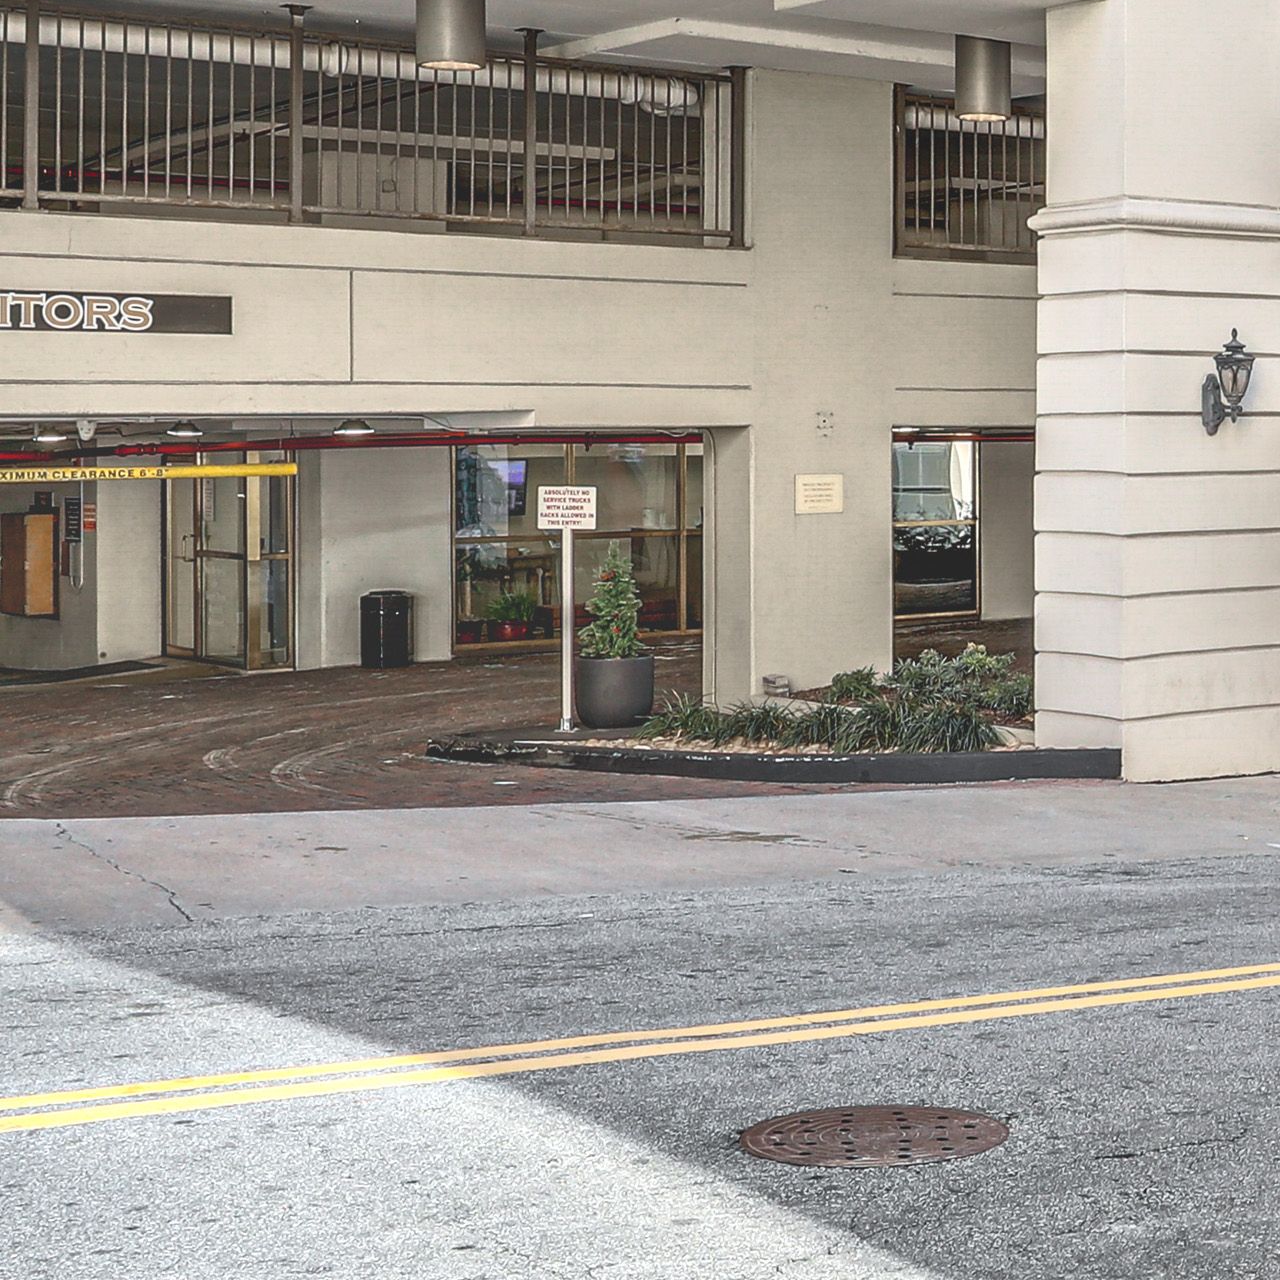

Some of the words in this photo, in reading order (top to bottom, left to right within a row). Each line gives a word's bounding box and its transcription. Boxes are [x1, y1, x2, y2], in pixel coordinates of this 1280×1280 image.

[0, 293, 153, 330] ITORS
[0, 471, 47, 480] XIMUM
[52, 469, 134, 479] CLEARANCE
